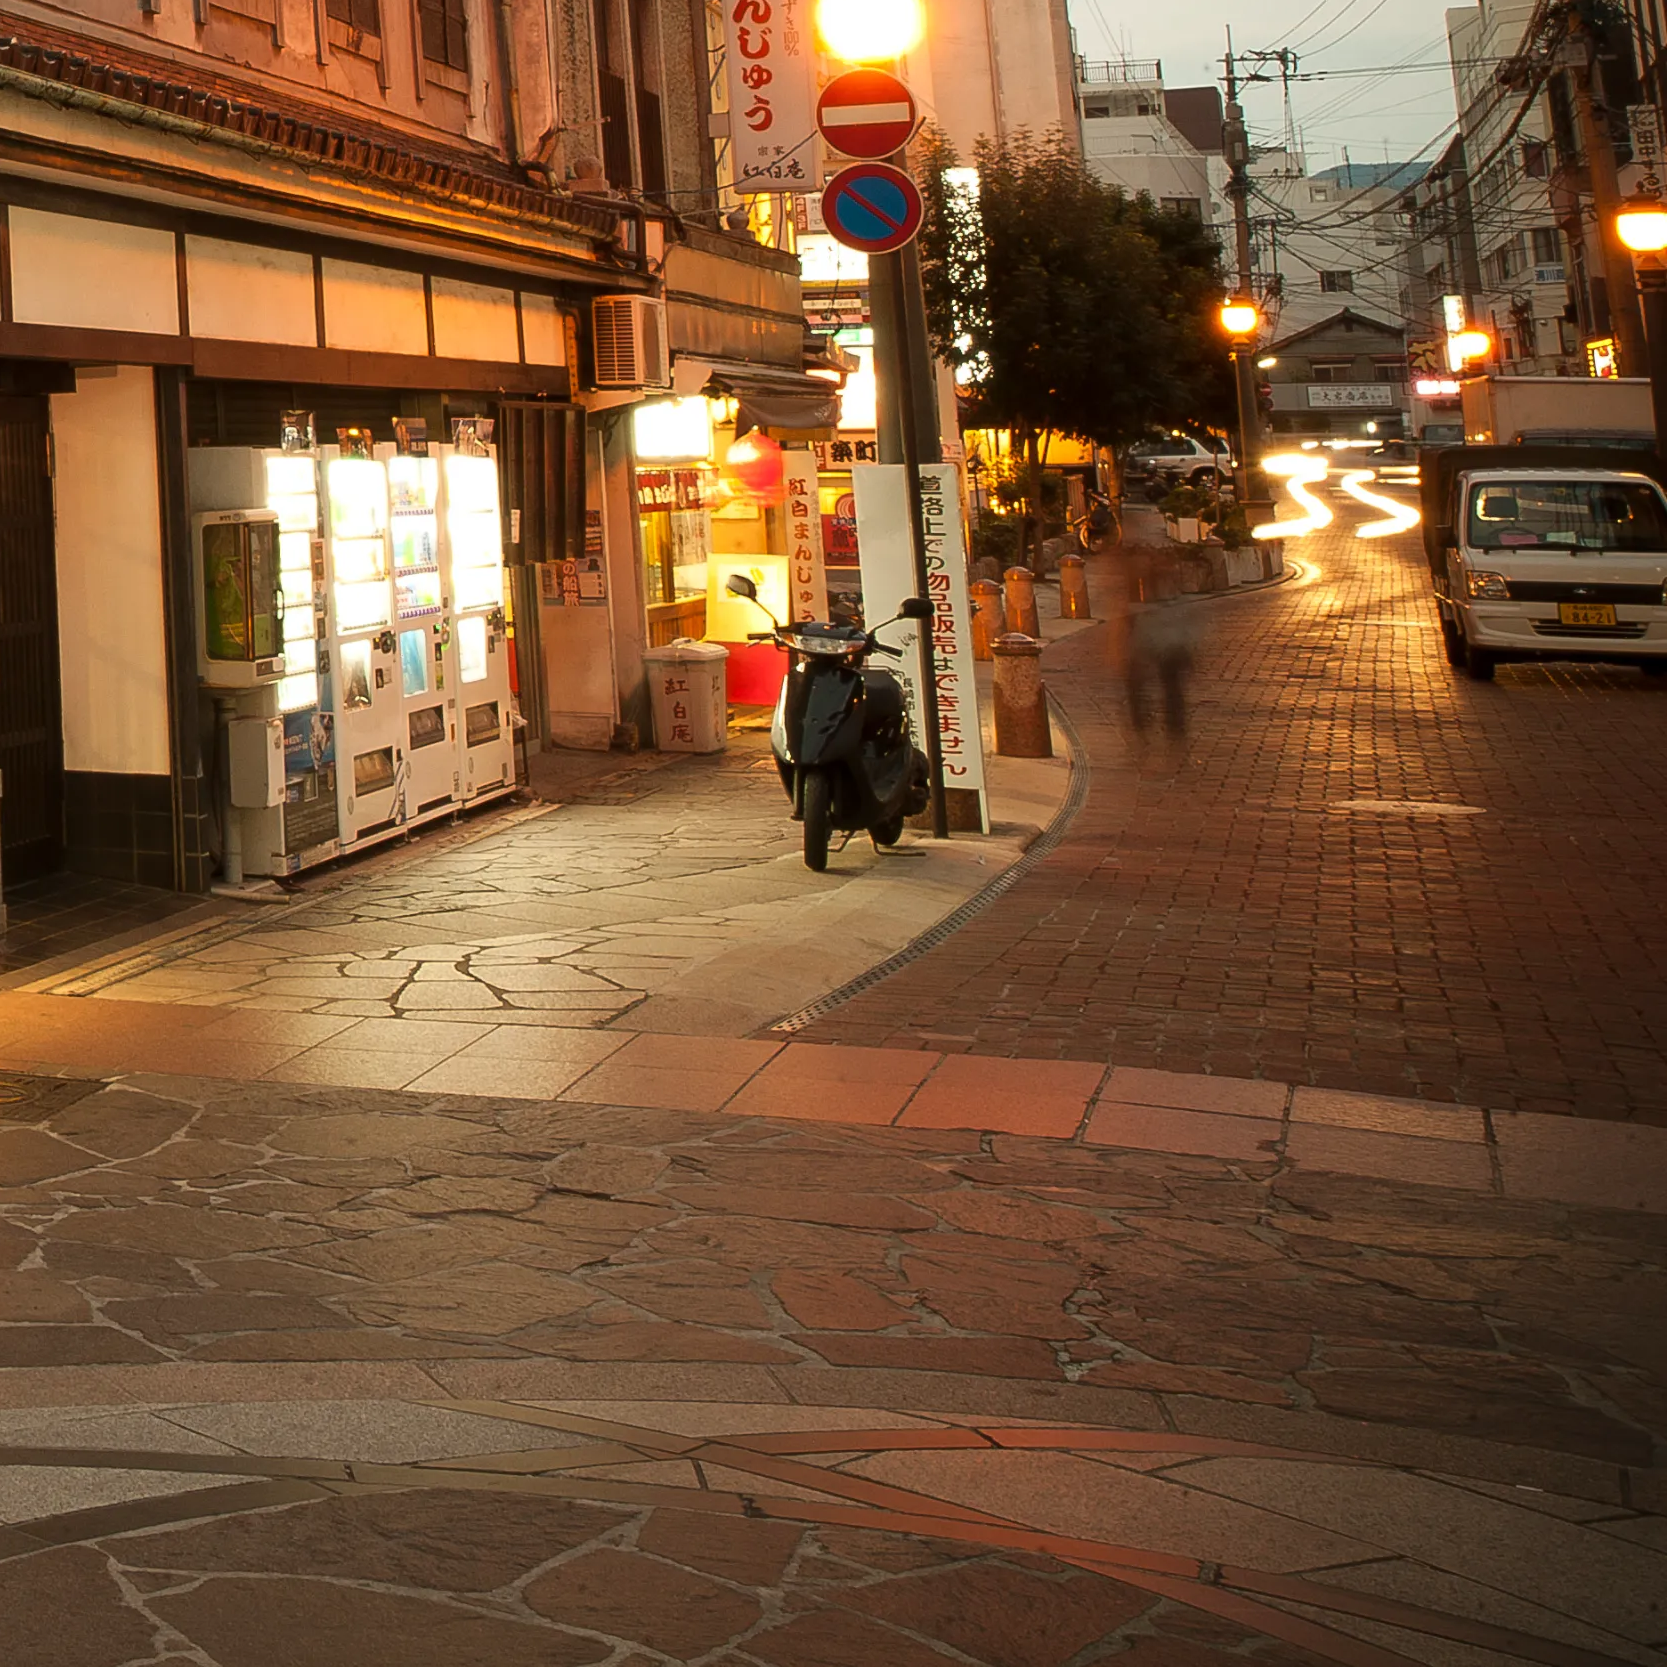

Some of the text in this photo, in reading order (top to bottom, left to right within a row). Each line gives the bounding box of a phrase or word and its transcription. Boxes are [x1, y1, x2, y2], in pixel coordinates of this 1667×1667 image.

[830, 439, 877, 463] 築町
[788, 478, 817, 622] 紅白まんじゅう
